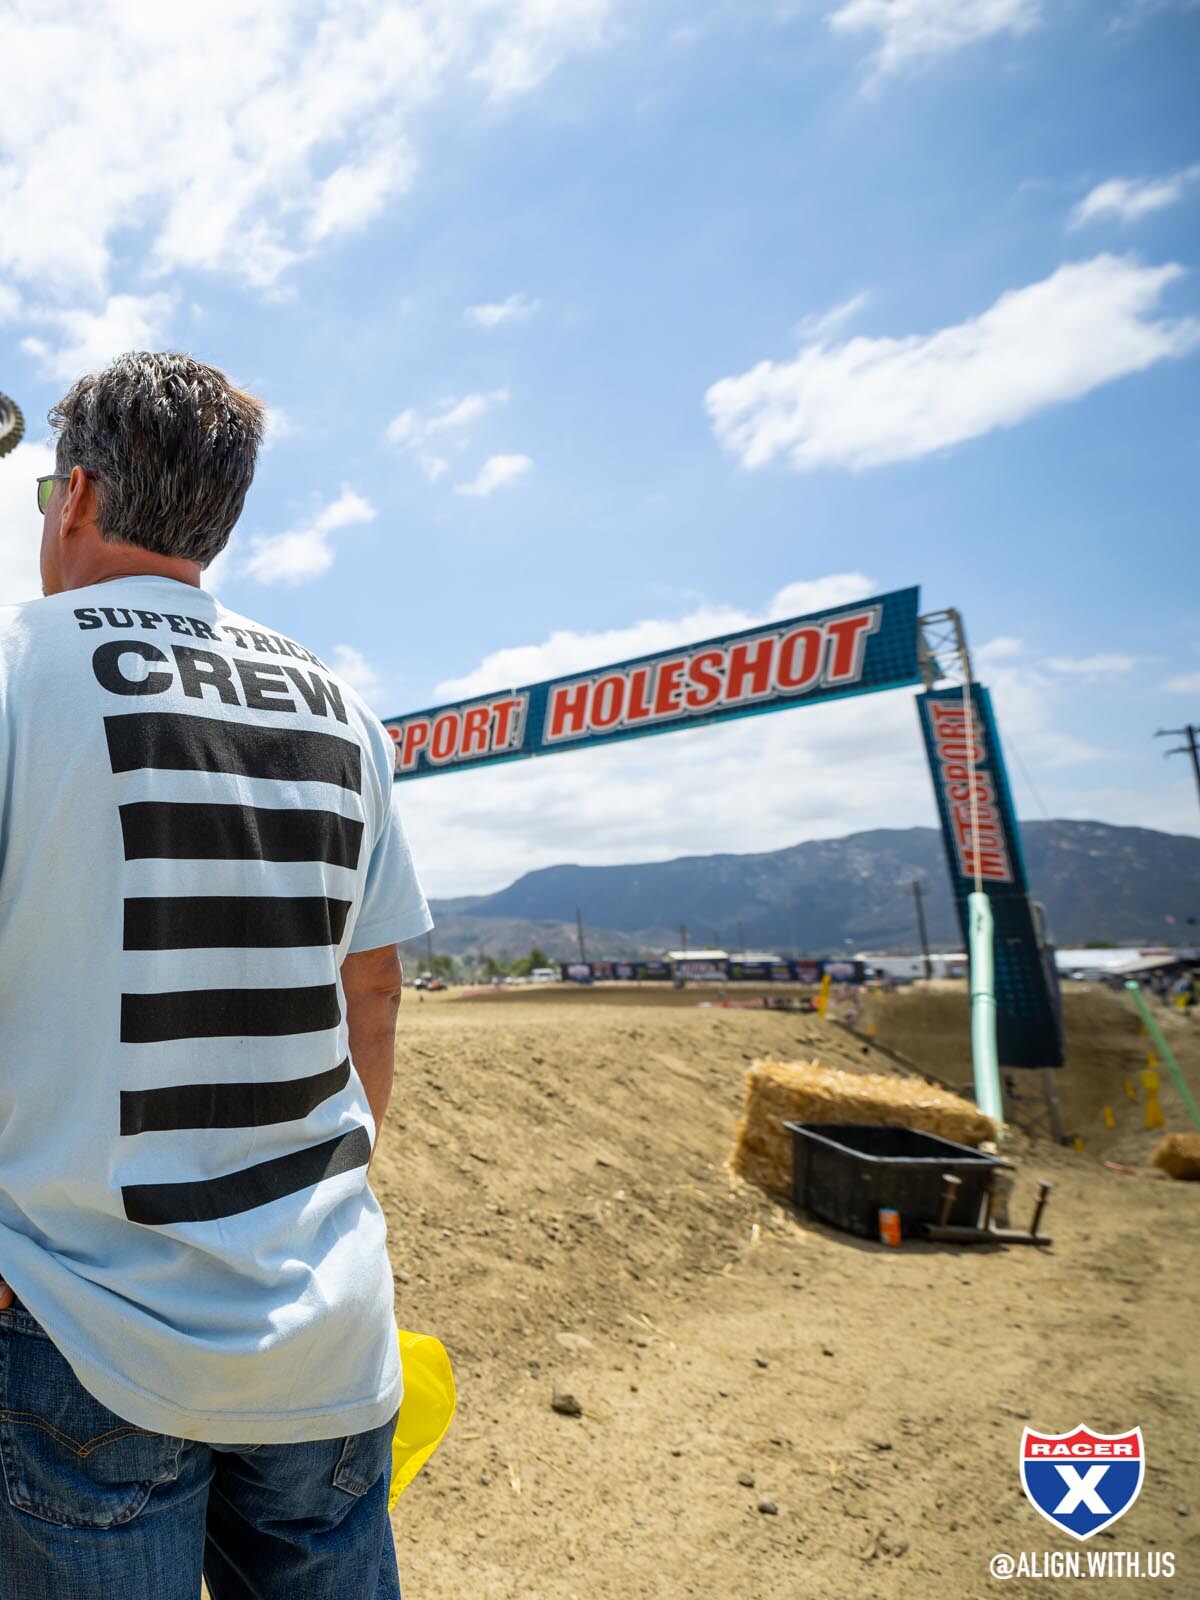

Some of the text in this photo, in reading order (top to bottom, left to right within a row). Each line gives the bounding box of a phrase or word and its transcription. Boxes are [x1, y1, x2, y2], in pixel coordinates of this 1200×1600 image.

[73, 607, 221, 642] SUPER
[91, 639, 349, 726] CREW
[550, 614, 870, 738] HOLESHOT
